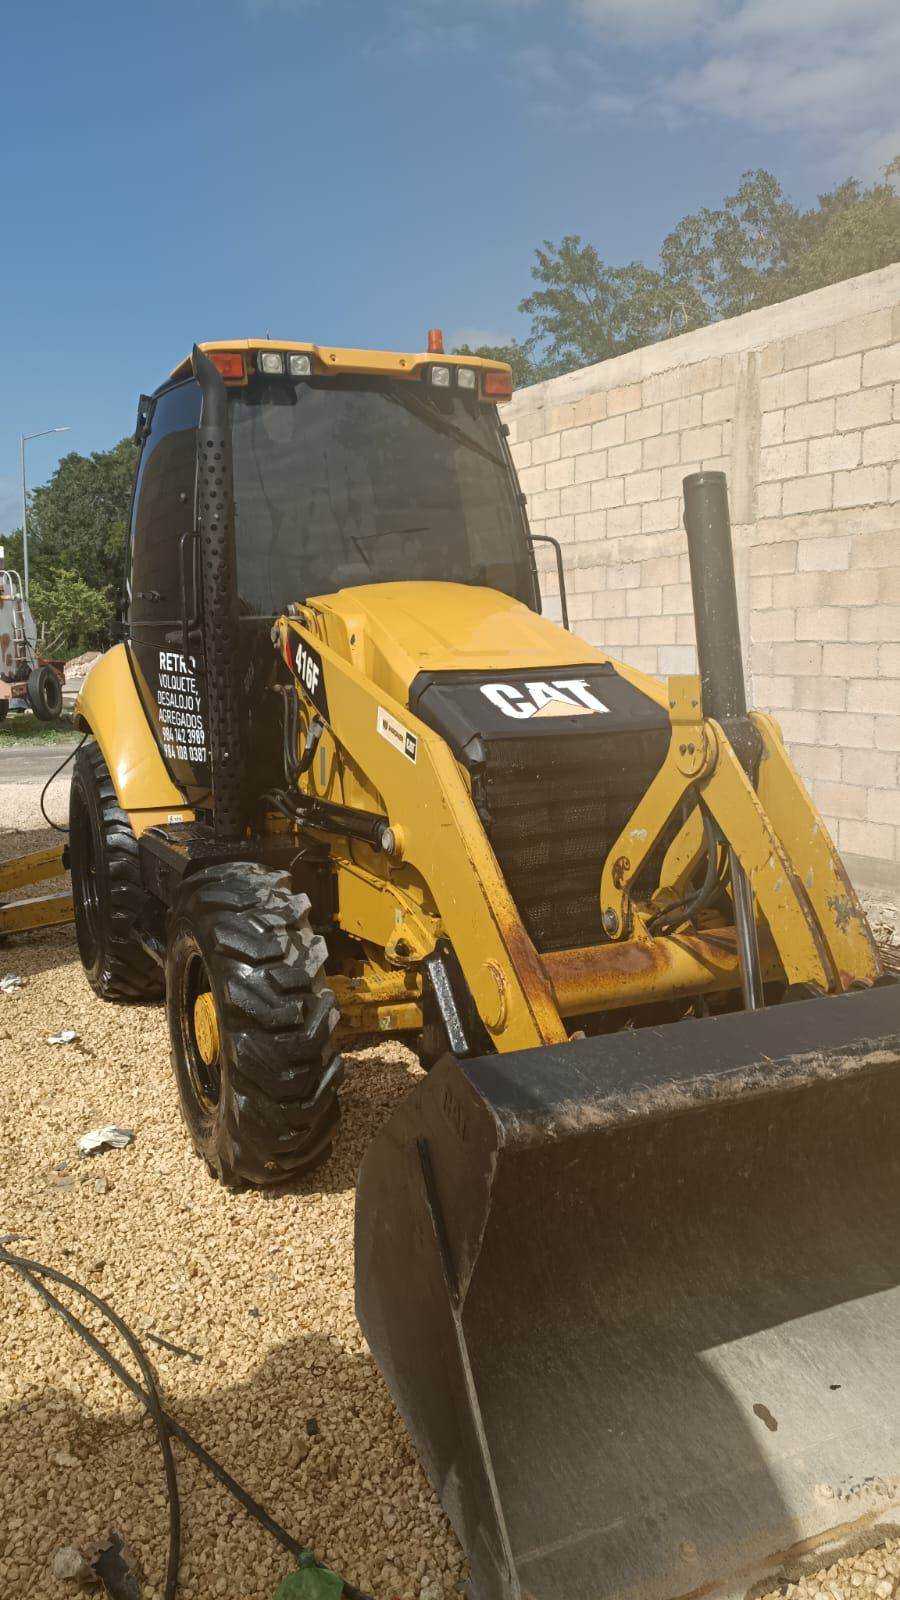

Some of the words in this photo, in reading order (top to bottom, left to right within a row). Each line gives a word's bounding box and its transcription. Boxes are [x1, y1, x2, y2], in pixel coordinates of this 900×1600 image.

[295, 643, 320, 696] 416F
[158, 673, 199, 696] VOLQUETE,
[157, 690, 194, 711] DESALOJO
[195, 697, 201, 713] Y
[480, 679, 611, 719] CAT
[158, 708, 203, 730] AGREGADOS
[174, 728, 187, 744] 142
[187, 729, 205, 745] 3989
[189, 746, 206, 763] 0387
